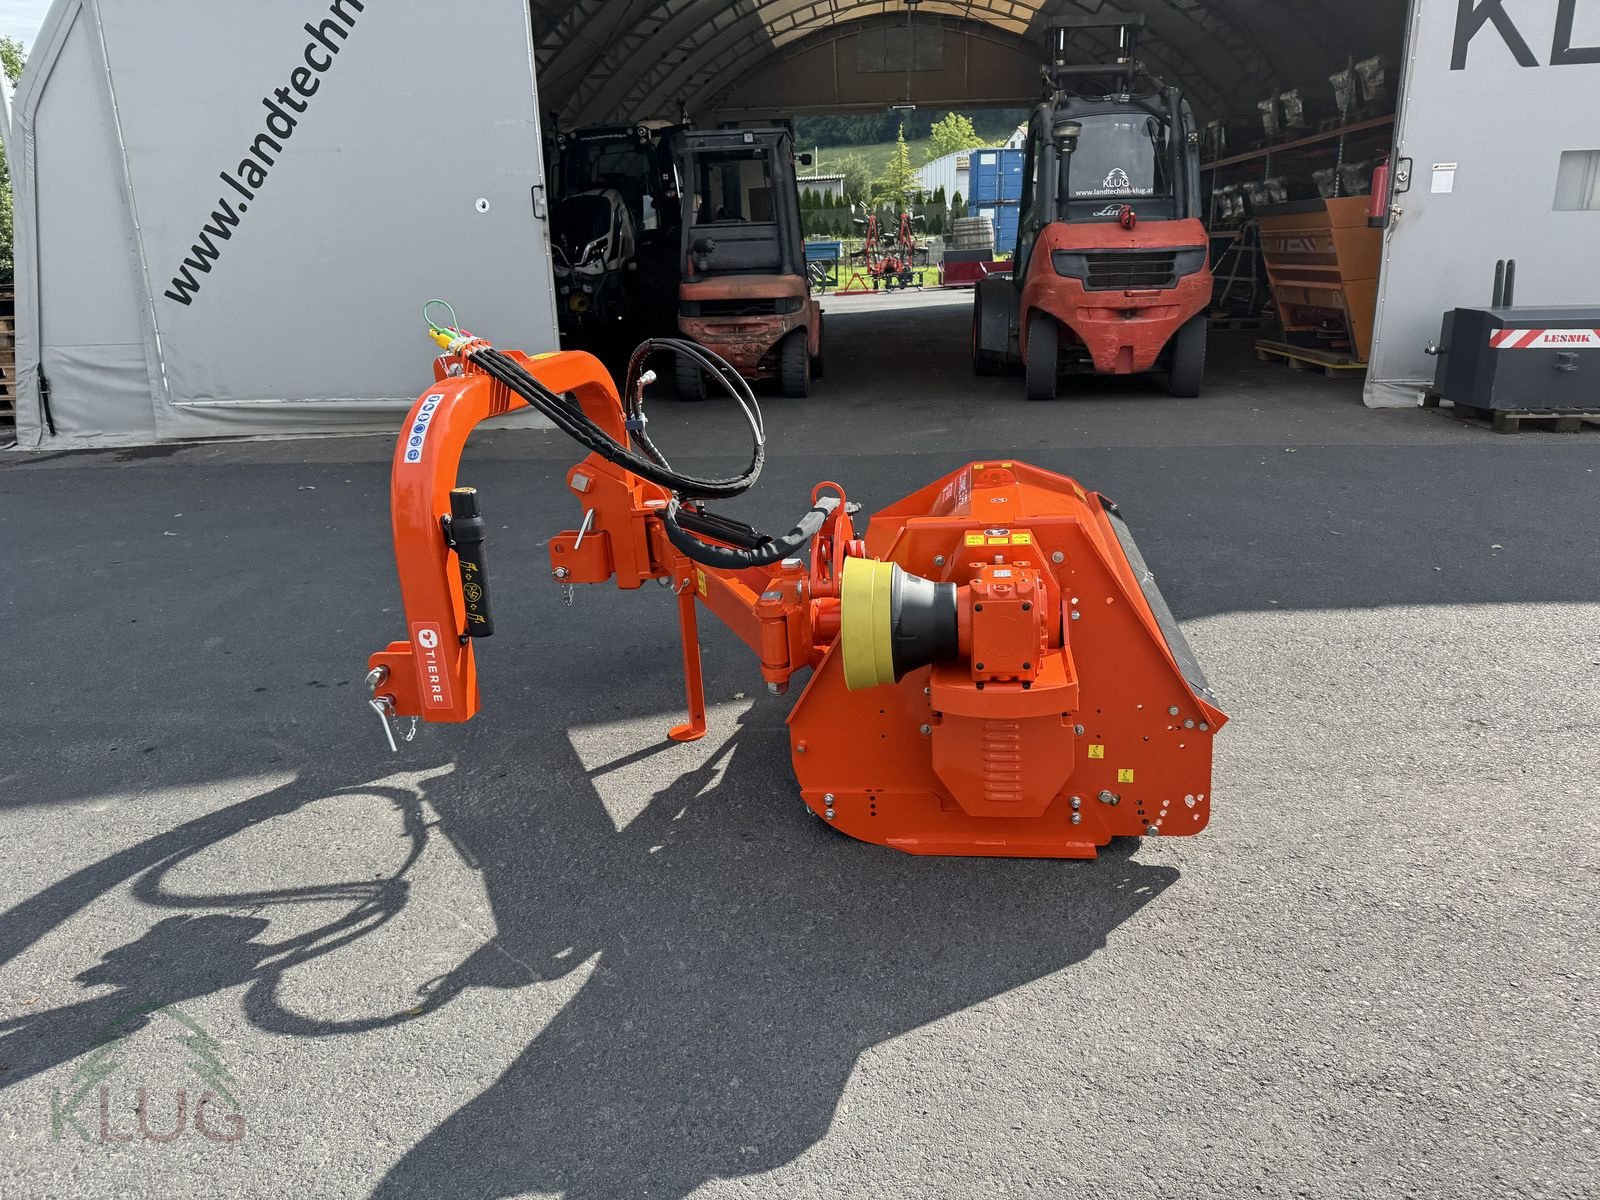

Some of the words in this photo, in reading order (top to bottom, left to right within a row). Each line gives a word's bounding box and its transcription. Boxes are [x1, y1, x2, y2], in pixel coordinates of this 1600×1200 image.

[1103, 179, 1130, 188] KLUG
[1075, 187, 1153, 196] www.landtechnik-klug.at
[1543, 334, 1591, 343] LESNIK
[425, 650, 443, 702] TIERRE
